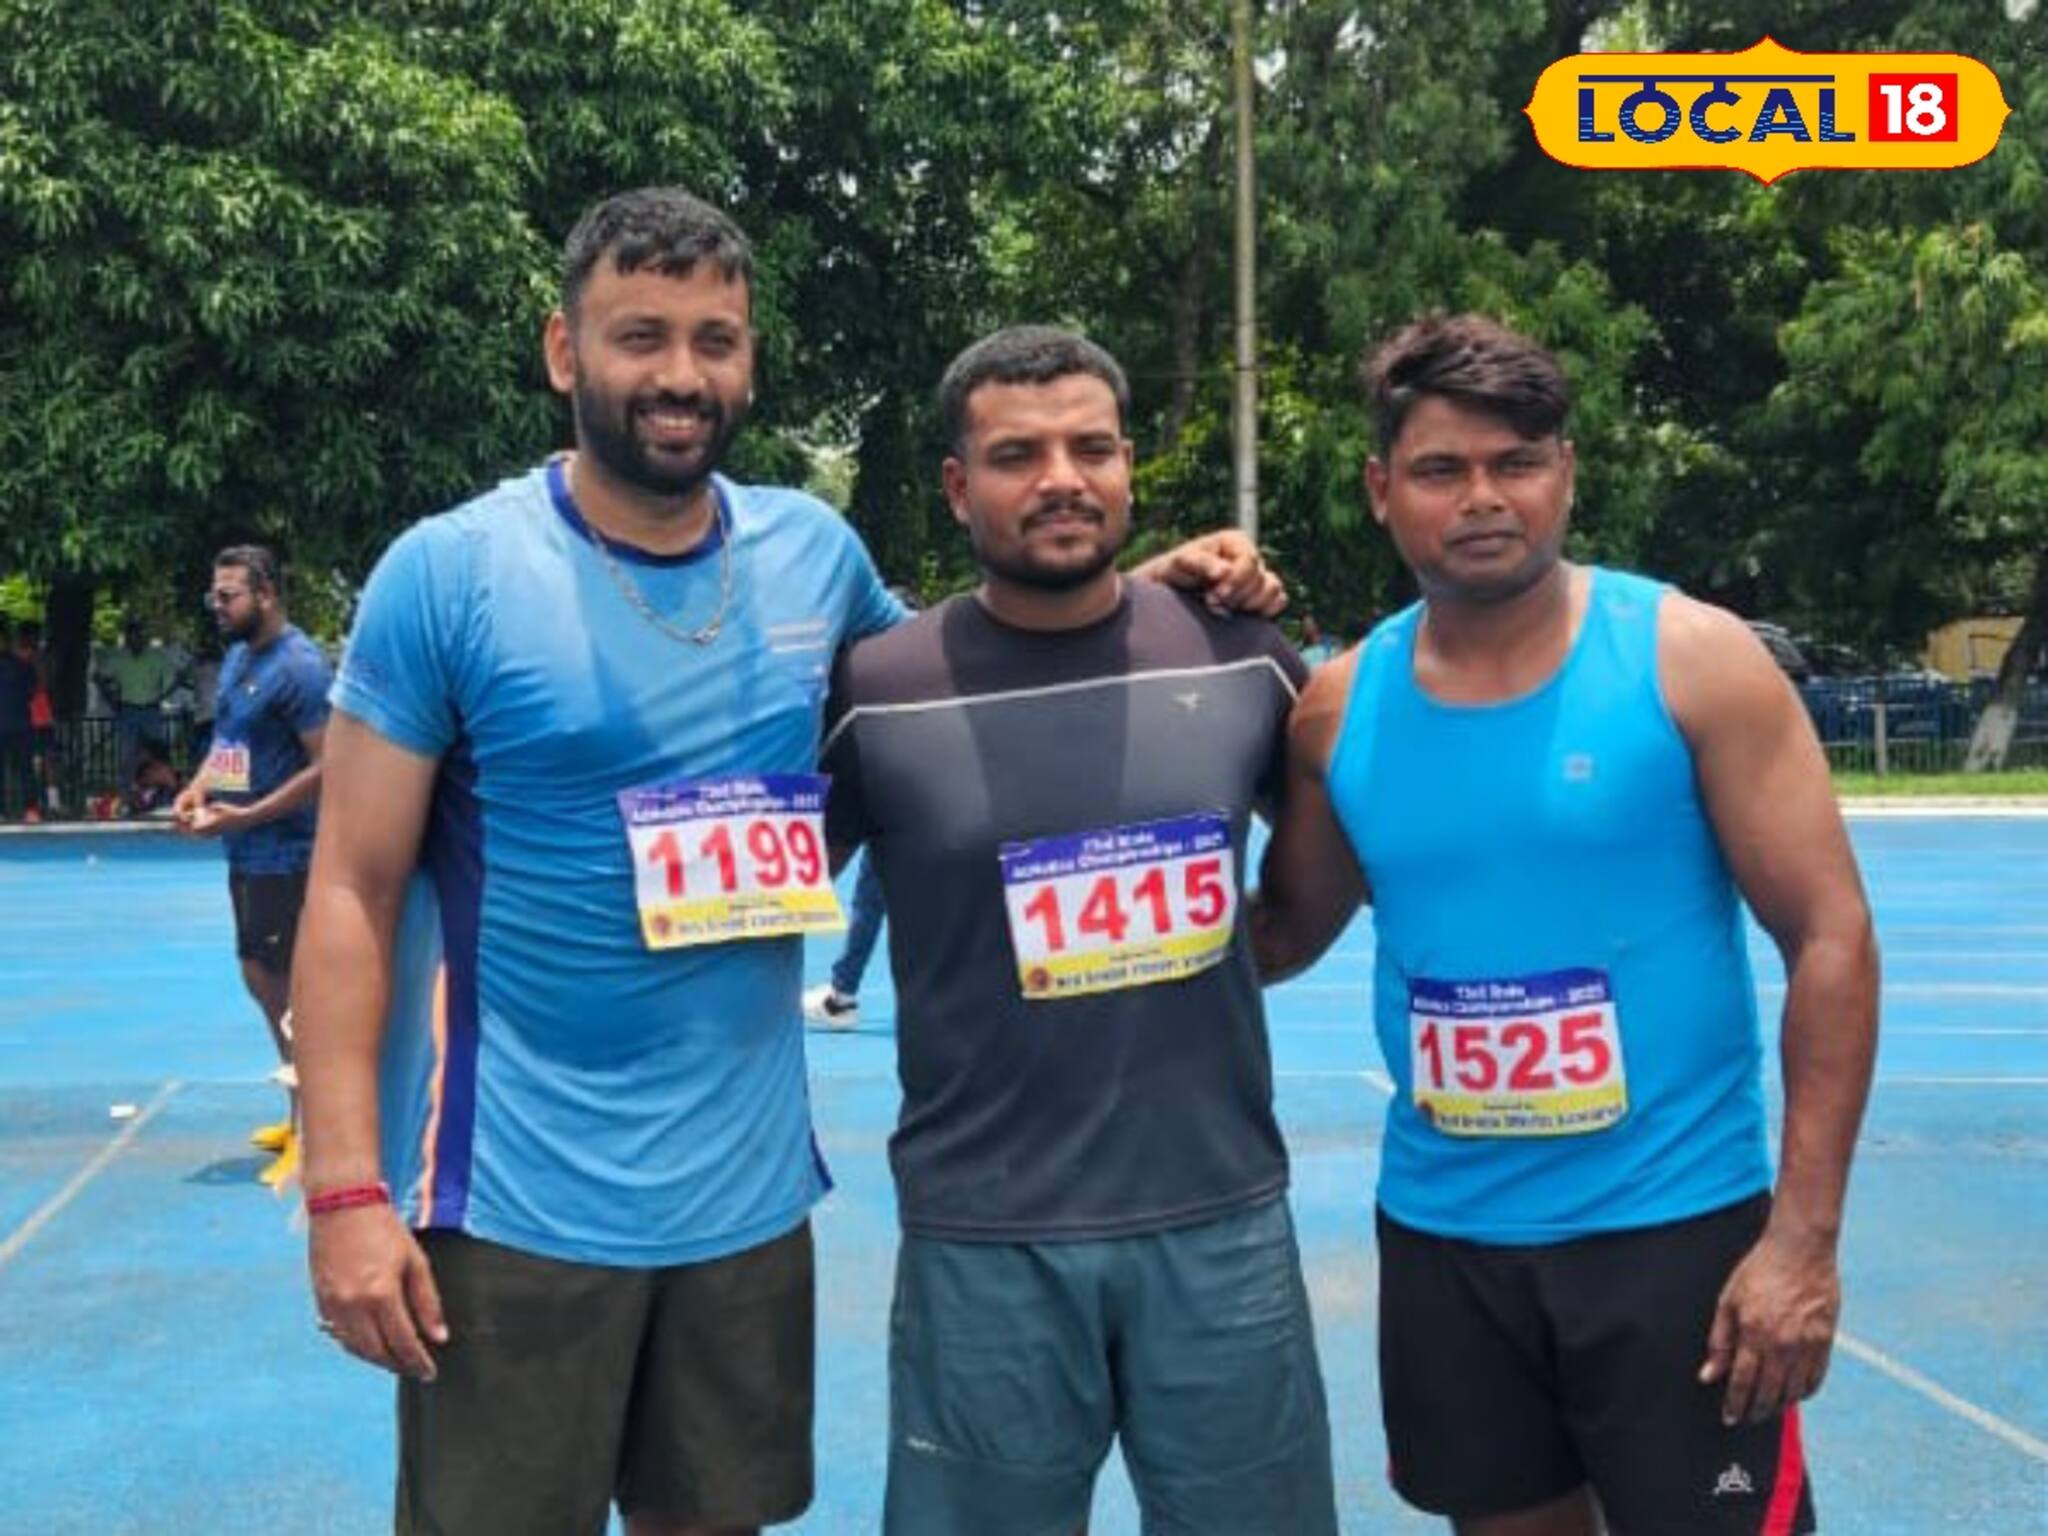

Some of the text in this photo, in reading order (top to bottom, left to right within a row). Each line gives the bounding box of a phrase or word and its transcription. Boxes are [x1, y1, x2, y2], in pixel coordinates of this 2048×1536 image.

[647, 820, 822, 898] 1199
[1024, 858, 1228, 952] 1415
[1420, 1012, 1611, 1092] 1525
